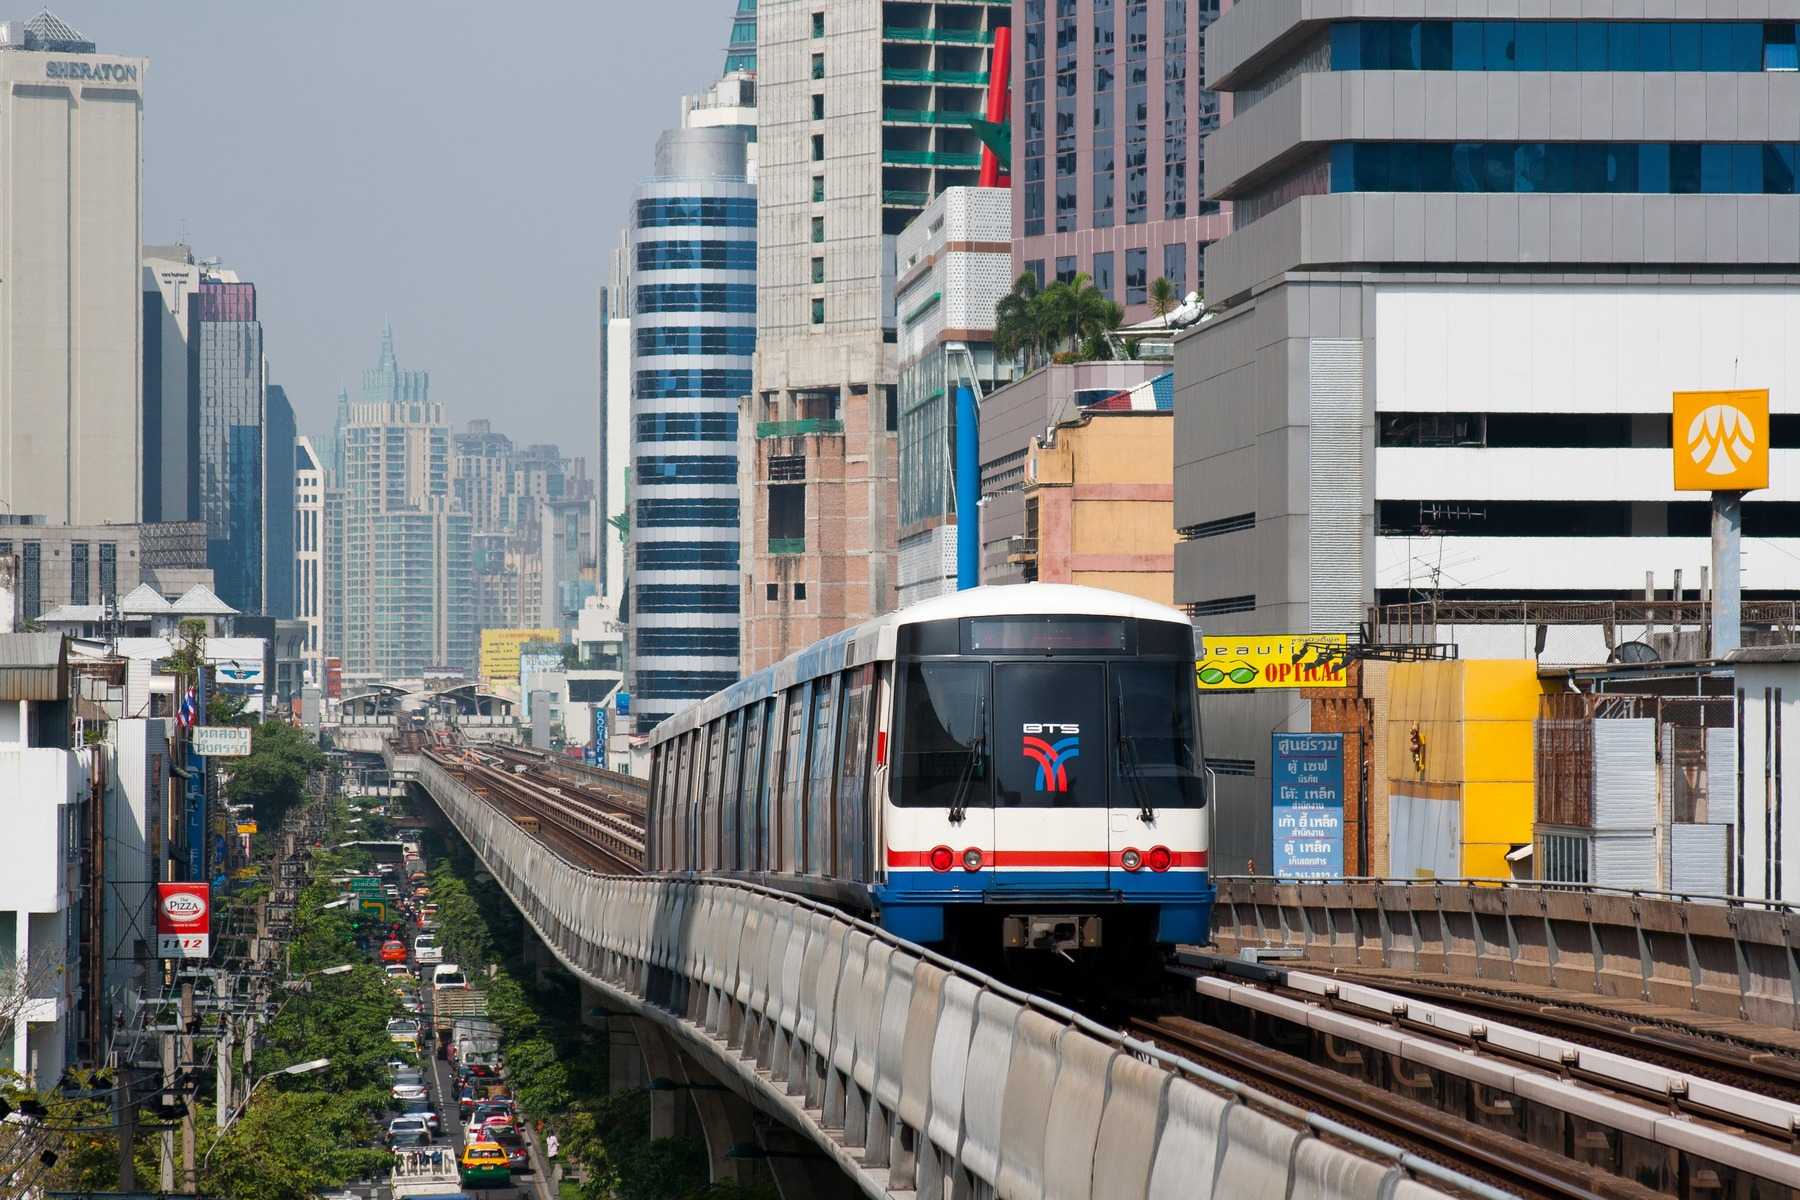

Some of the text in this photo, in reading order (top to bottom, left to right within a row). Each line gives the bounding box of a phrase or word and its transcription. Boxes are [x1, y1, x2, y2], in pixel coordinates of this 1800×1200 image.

[46, 60, 137, 82] SHERATON
[1264, 663, 1344, 683] OPTICAL
[1023, 723, 1080, 734] BTS
[1279, 737, 1338, 754] ศูนย์รวม
[1304, 786, 1336, 799] เหล็ก
[1309, 814, 1338, 828] เหล็ก
[1299, 840, 1331, 853] เหล็ก
[170, 901, 198, 911] PIZZA
[161, 939, 203, 949] 1112
